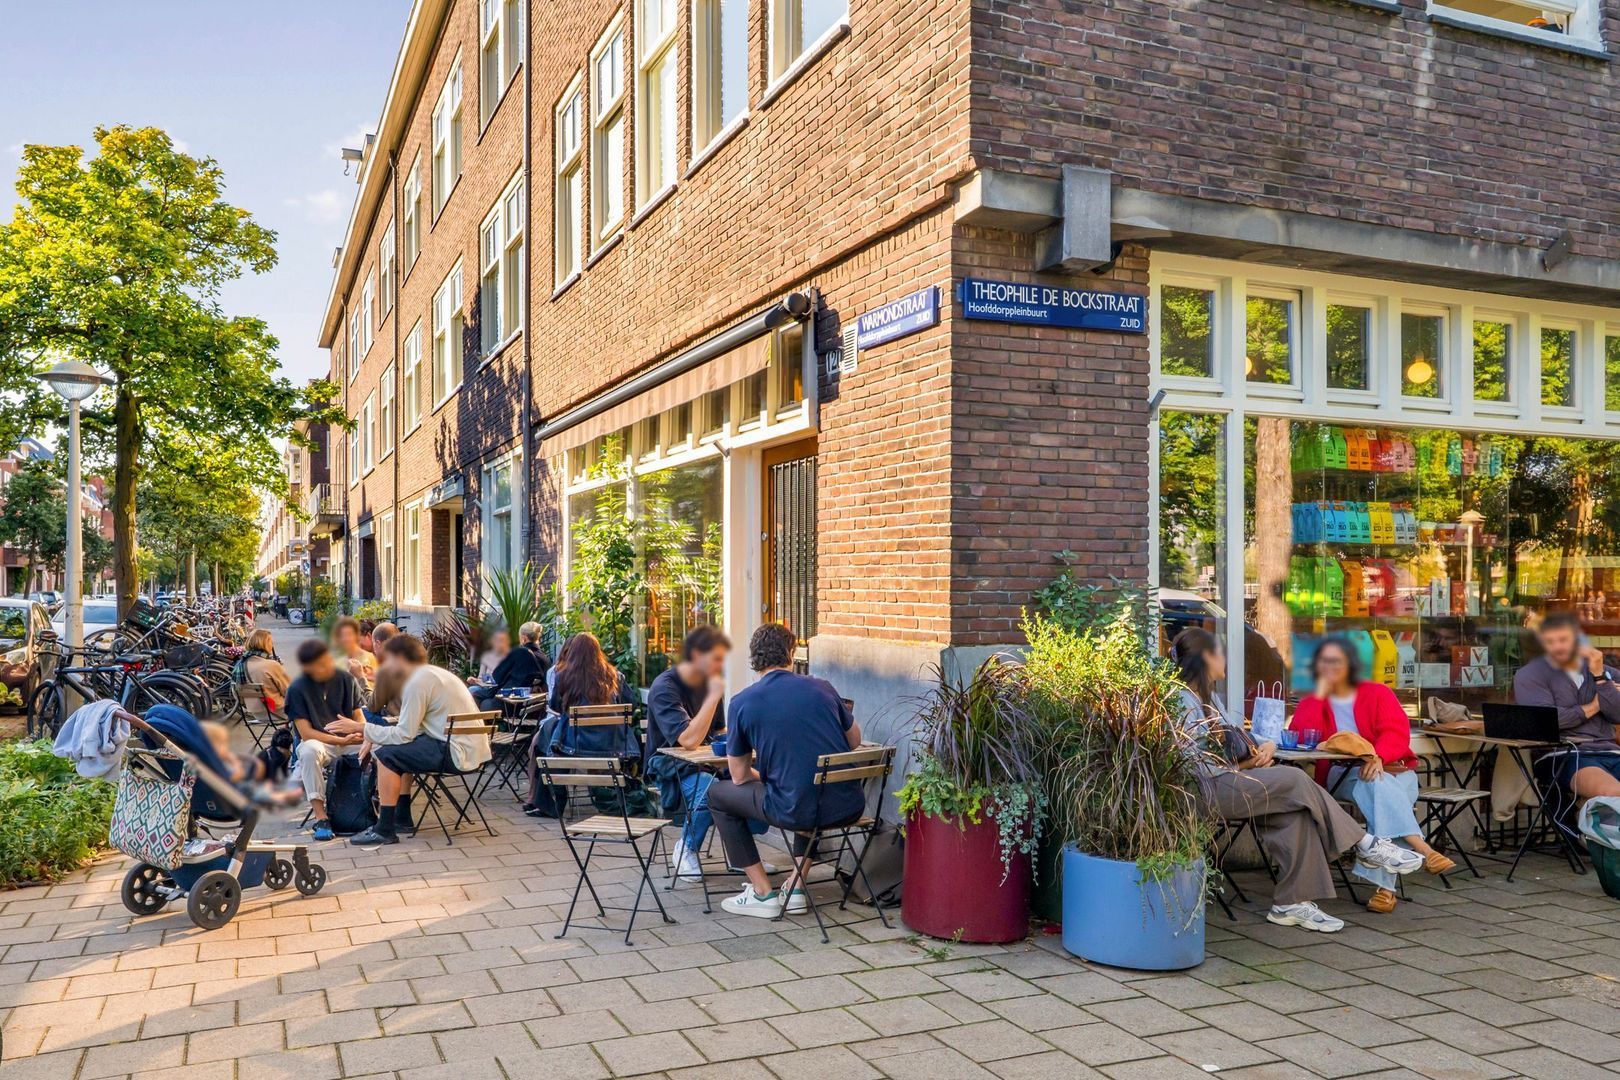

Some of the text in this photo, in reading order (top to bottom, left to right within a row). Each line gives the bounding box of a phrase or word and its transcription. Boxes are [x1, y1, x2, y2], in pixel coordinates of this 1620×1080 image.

[972, 282, 1140, 313] THEOPHILE DE BOCKSTRAAT
[861, 291, 928, 332] WARMONDSTRAAT
[968, 302, 1048, 318] Hoofddorppleinbuurt
[1120, 317, 1141, 329] ZUID
